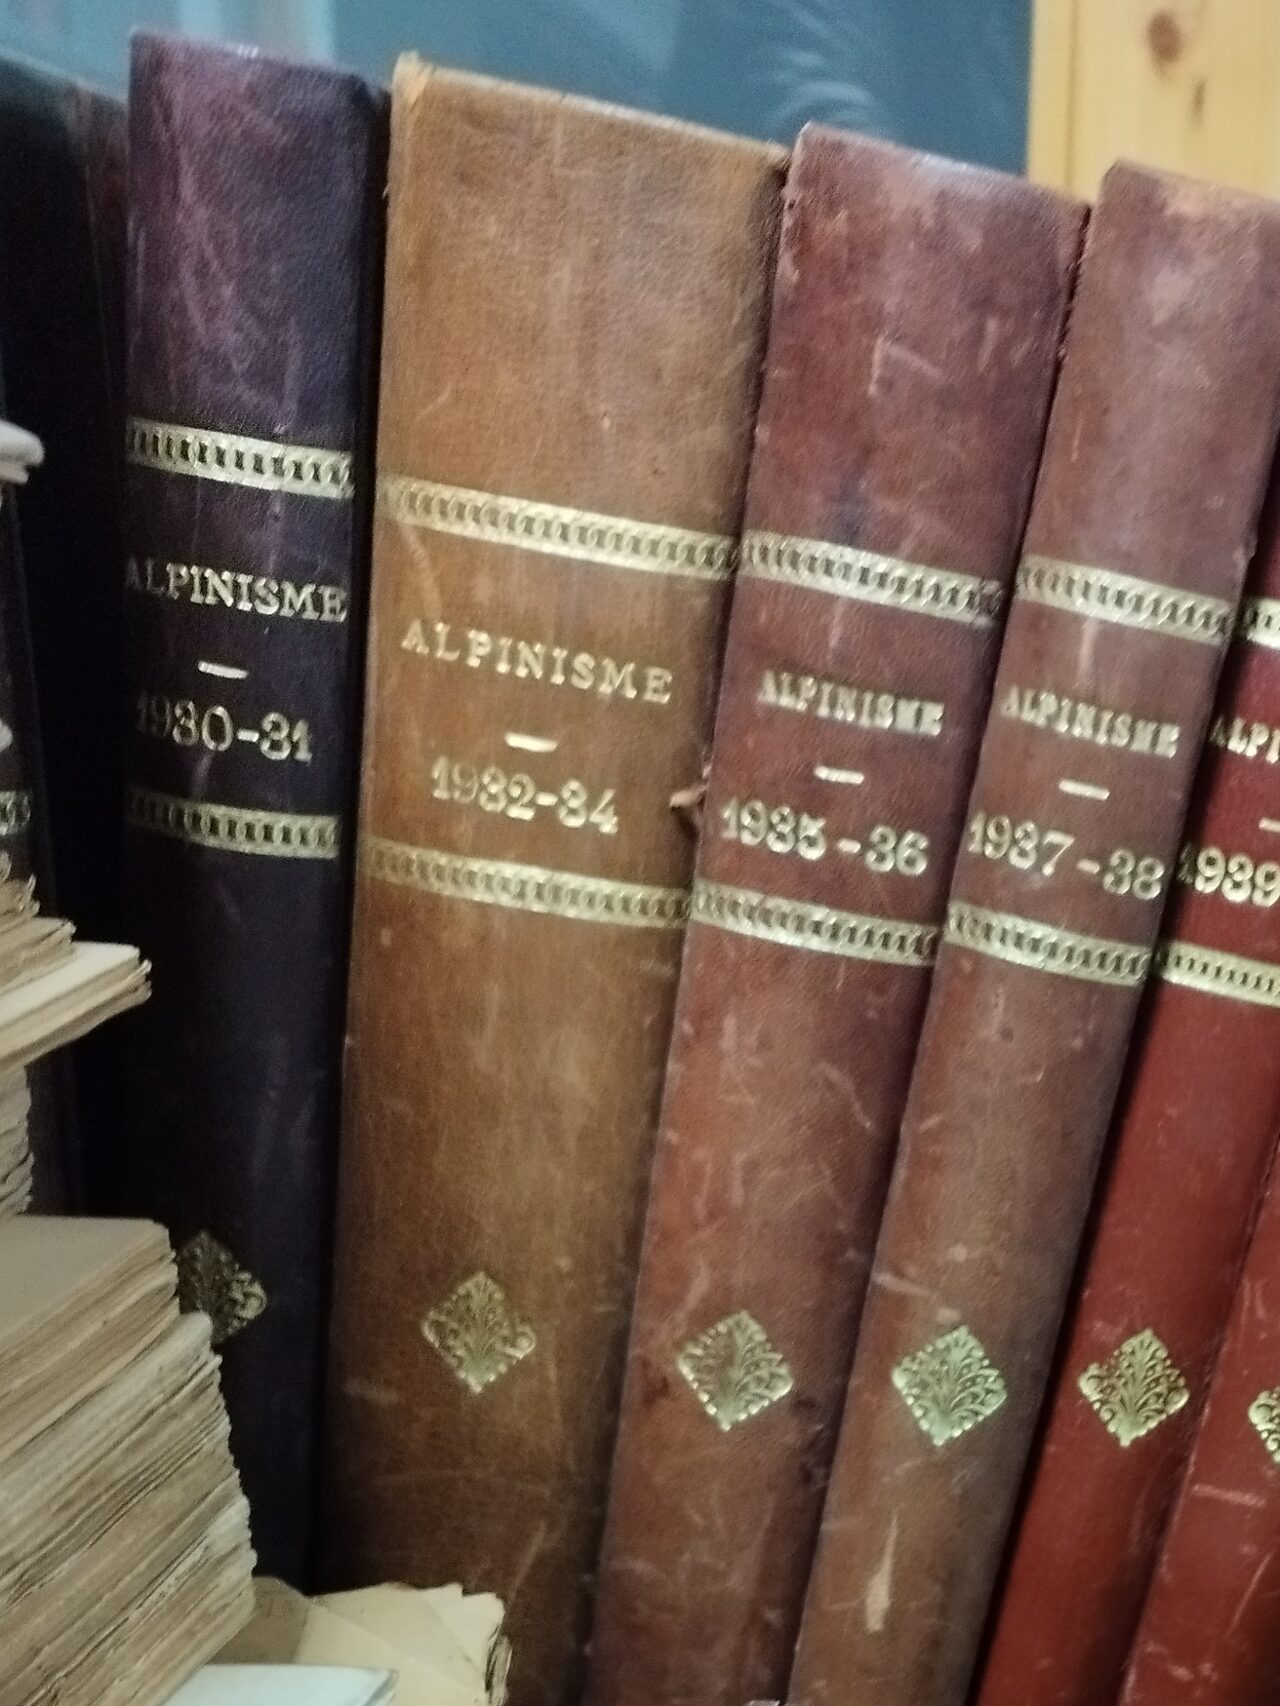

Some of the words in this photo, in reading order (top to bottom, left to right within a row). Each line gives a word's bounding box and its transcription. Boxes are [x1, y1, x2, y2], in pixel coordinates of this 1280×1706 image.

[125, 556, 348, 623] ALPINISME
[402, 620, 674, 703] ALPINISME
[137, 698, 313, 764] 1930-31
[758, 670, 944, 737] ALPINISME
[1002, 686, 1181, 758] ALPINISME
[431, 756, 619, 835] 1932-34
[721, 797, 929, 876] 1935-36
[968, 812, 1165, 900] 1937-38
